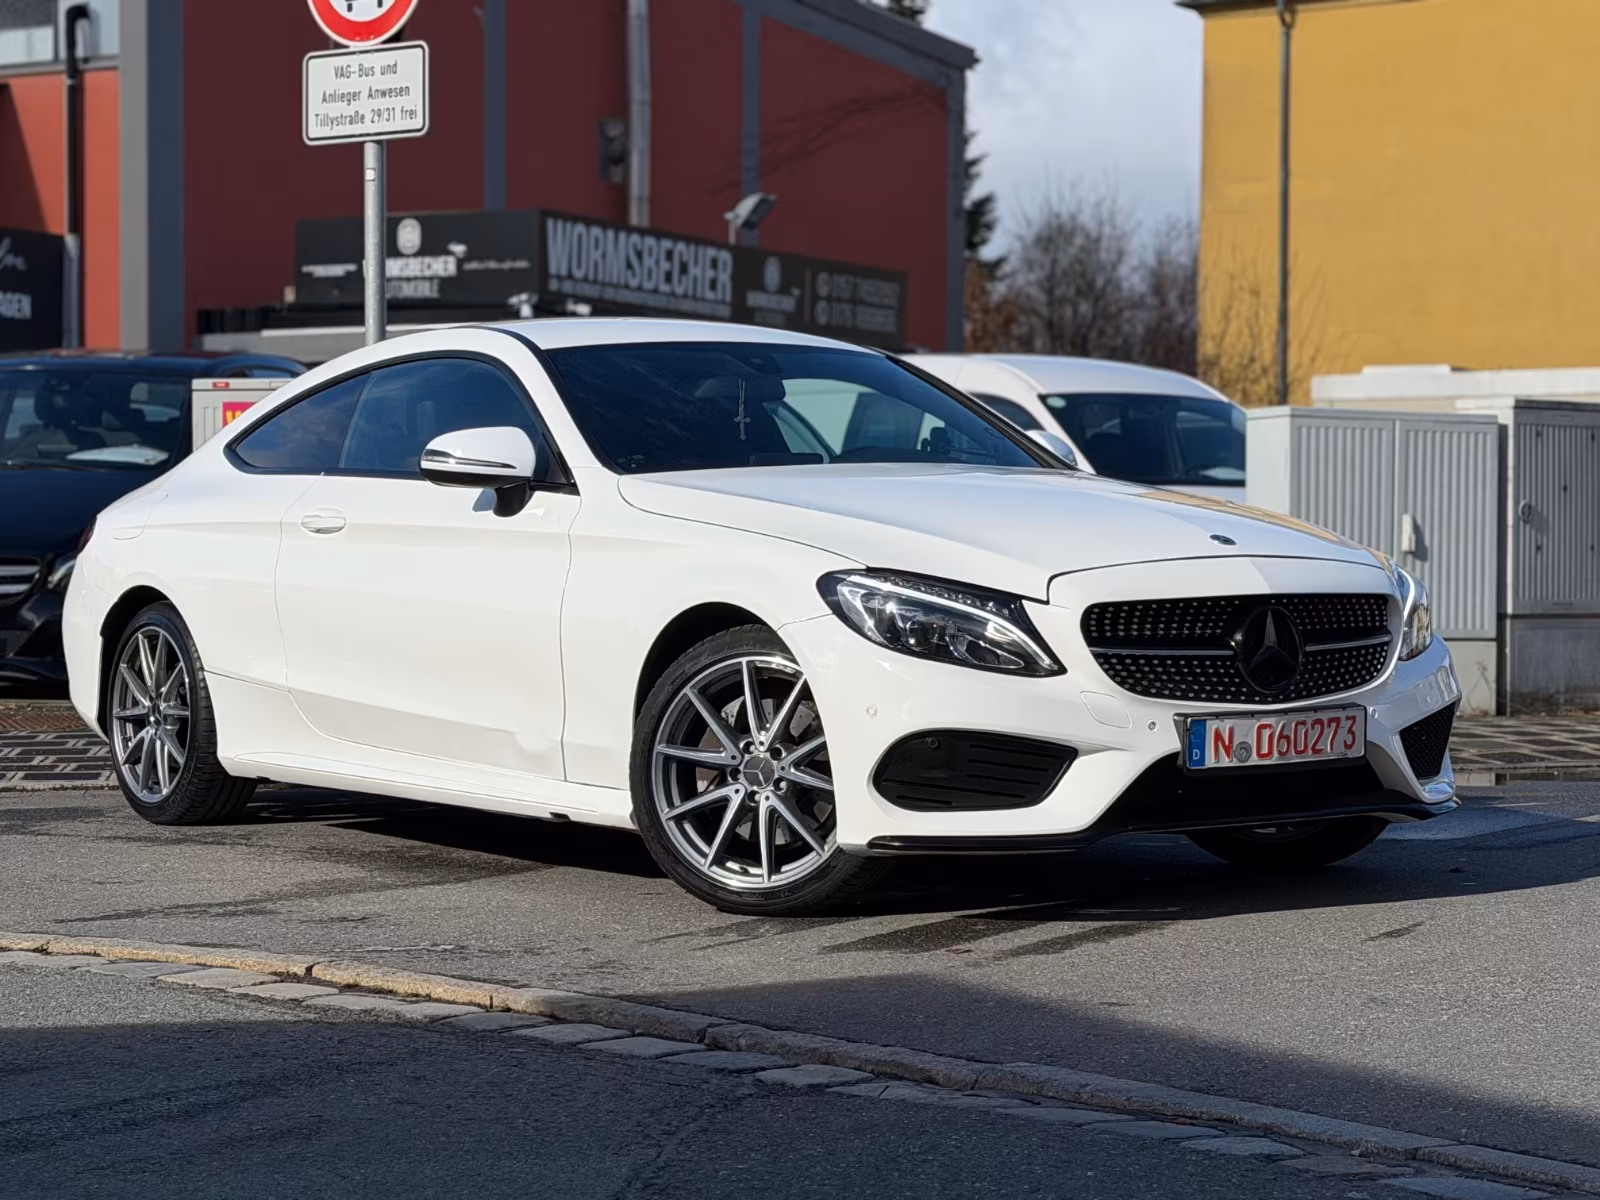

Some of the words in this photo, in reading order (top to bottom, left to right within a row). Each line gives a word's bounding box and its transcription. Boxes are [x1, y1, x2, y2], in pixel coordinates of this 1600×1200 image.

[333, 63, 375, 80] VAG-Bus
[380, 60, 398, 75] und
[321, 88, 362, 106] Anlieger
[367, 85, 410, 101] Anwesen
[314, 110, 366, 131] Tillystraße
[370, 107, 396, 124] 29/31
[400, 105, 418, 121] frei
[546, 217, 734, 303] WORMSBECHER
[1211, 724, 1235, 763] N
[1254, 715, 1357, 760] 060273
[1192, 749, 1201, 760] D
